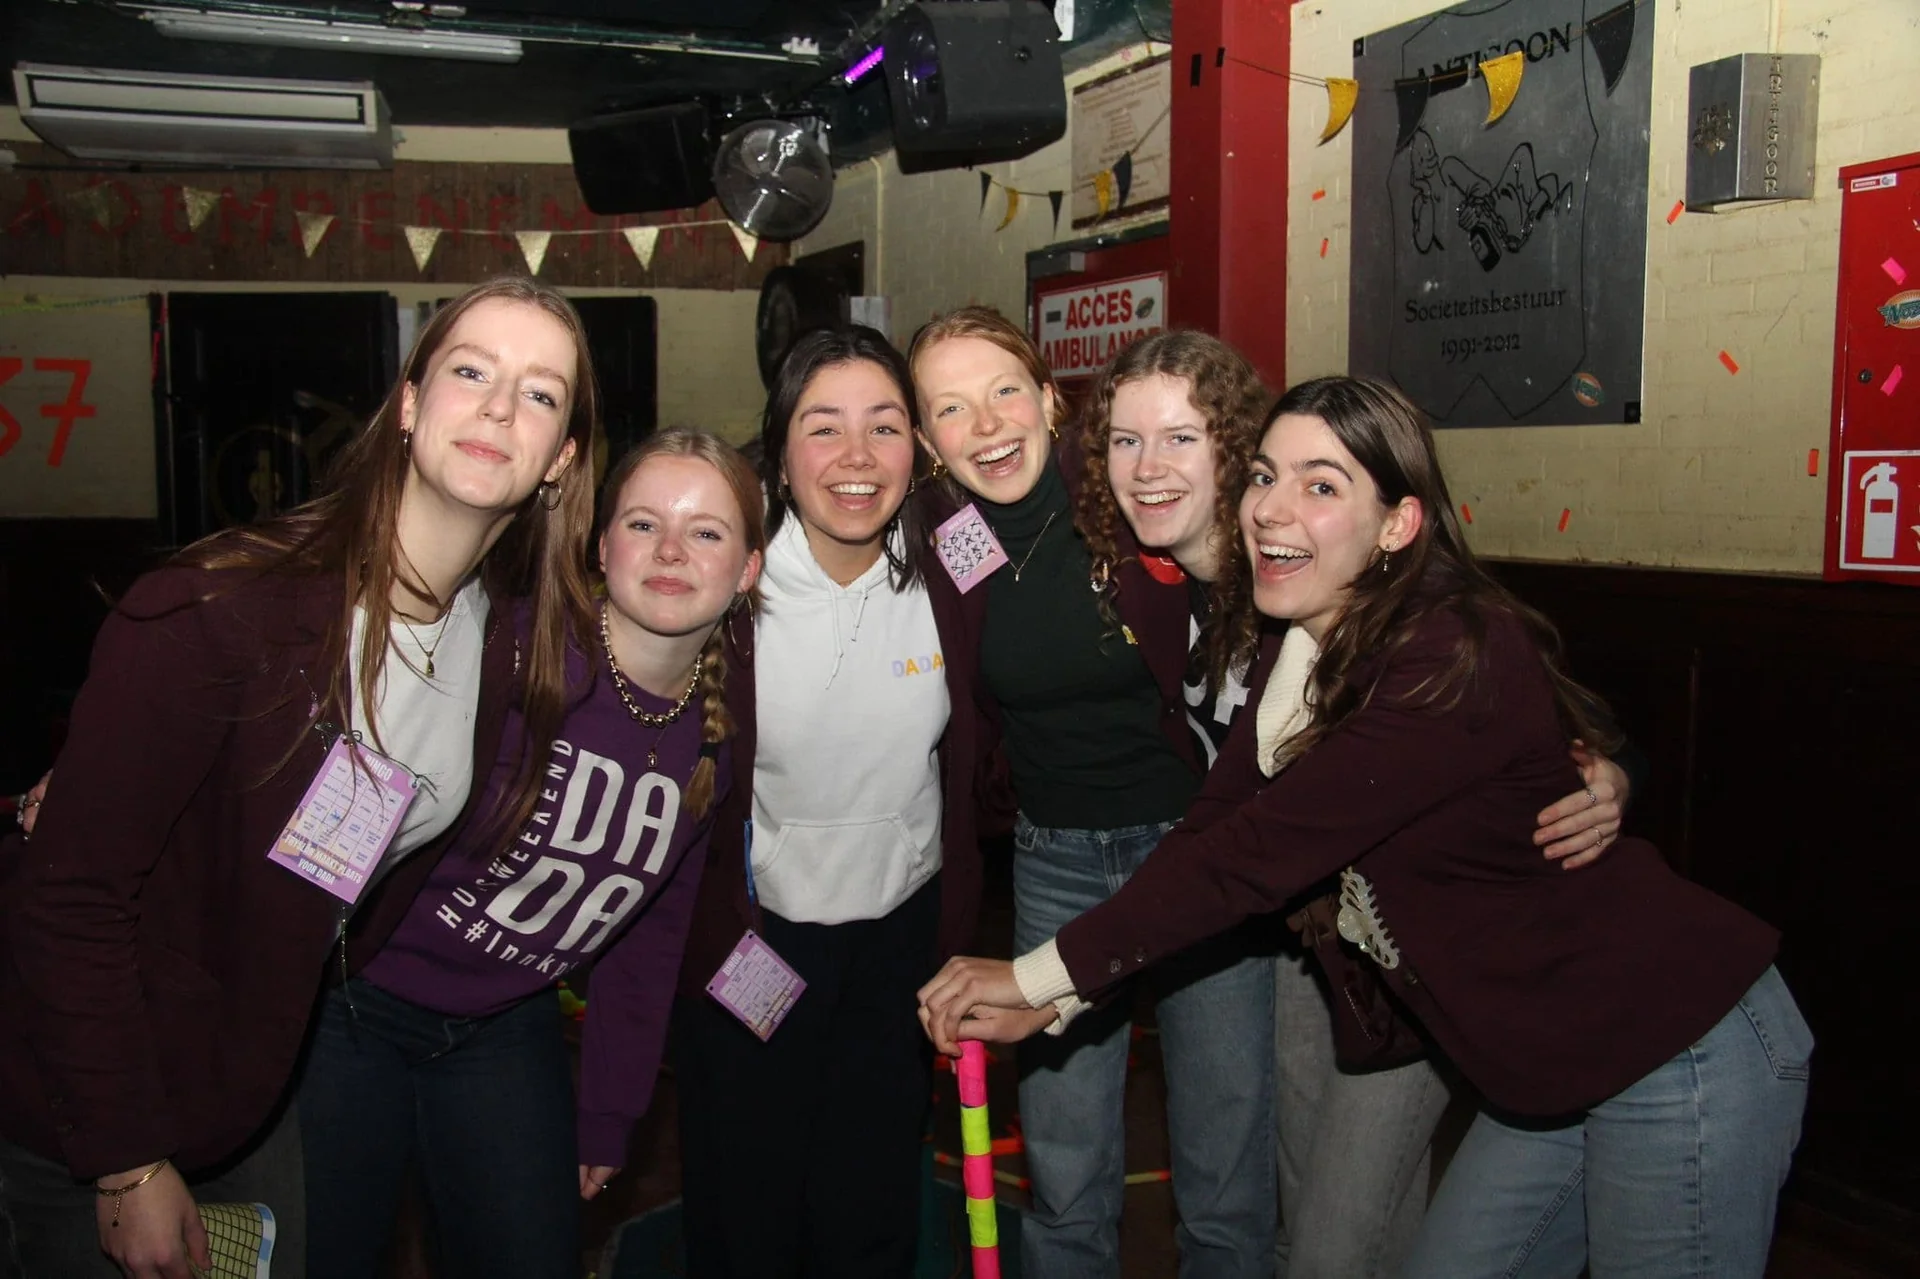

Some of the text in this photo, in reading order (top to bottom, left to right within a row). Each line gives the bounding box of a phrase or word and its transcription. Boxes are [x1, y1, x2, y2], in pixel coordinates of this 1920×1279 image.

[1065, 289, 1132, 331] ACCES
[1043, 327, 1160, 370] AMBULAN
[1441, 333, 1521, 364] 1991-2012
[891, 652, 944, 678] DADA
[549, 749, 680, 875] DA
[298, 858, 336, 885] VOOR DADA
[484, 856, 644, 953] DA
